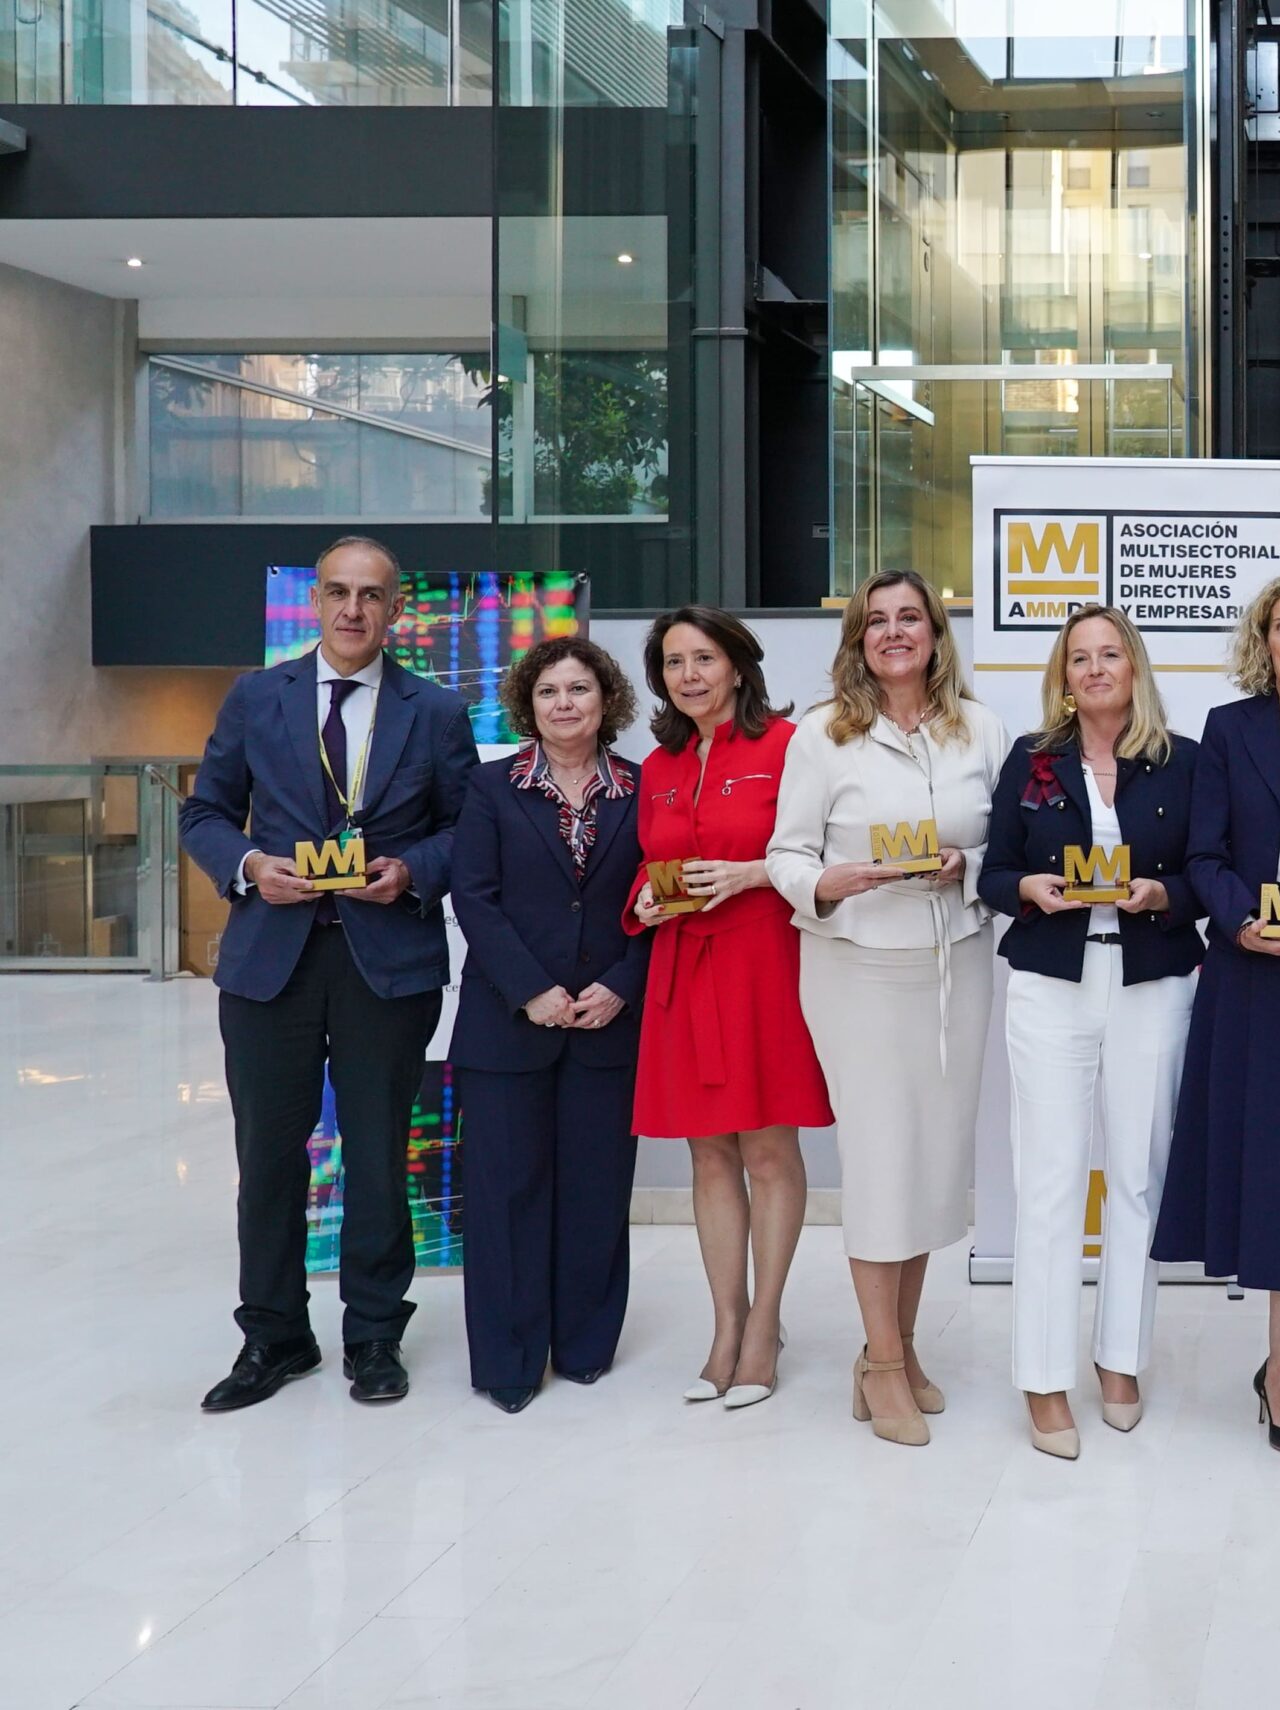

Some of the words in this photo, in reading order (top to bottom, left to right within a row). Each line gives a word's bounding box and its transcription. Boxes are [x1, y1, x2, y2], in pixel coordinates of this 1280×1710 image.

[1120, 521, 1238, 539] ASOCIACIÓN
[1120, 544, 1280, 559] MULTISECTORIAL
[1120, 564, 1145, 578] DE
[1149, 564, 1237, 579] MUJERES
[1120, 584, 1231, 599] DIRECTIVAS
[1008, 601, 1099, 618] AMMD
[1120, 604, 1132, 618] Y
[1136, 604, 1244, 619] EMPRESARI
